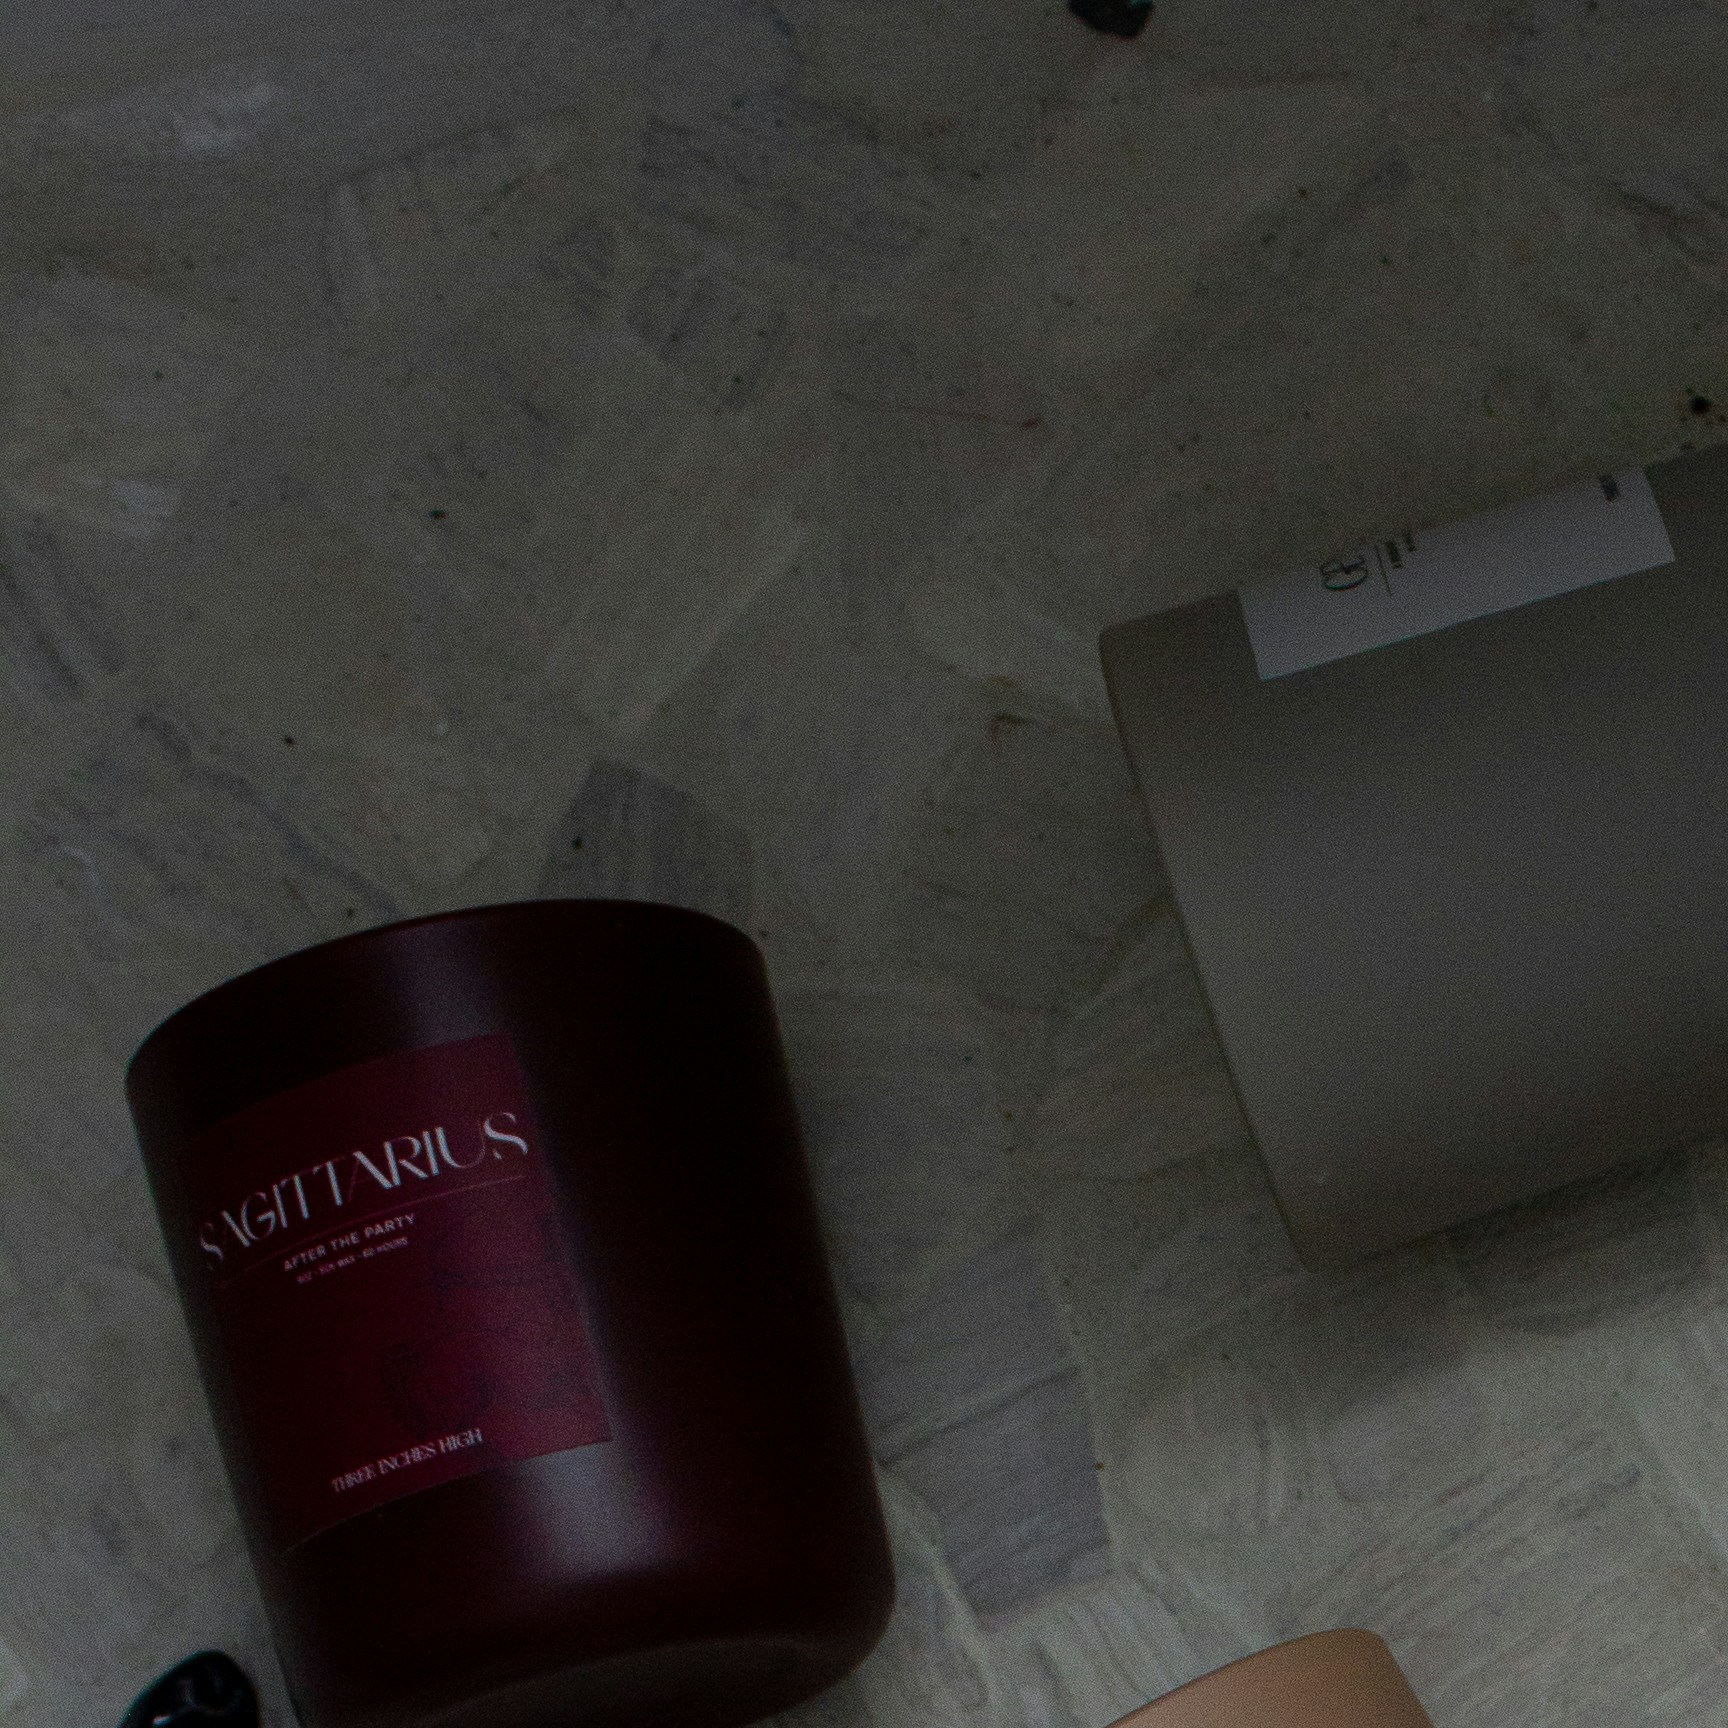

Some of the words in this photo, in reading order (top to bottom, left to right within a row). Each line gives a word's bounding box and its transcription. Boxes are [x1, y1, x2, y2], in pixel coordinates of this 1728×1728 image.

[200, 1111, 531, 1267] SAGITTARIUS
[283, 1244, 327, 1272] AFTER
[329, 1231, 360, 1250] THE
[363, 1213, 415, 1238] PARTY
